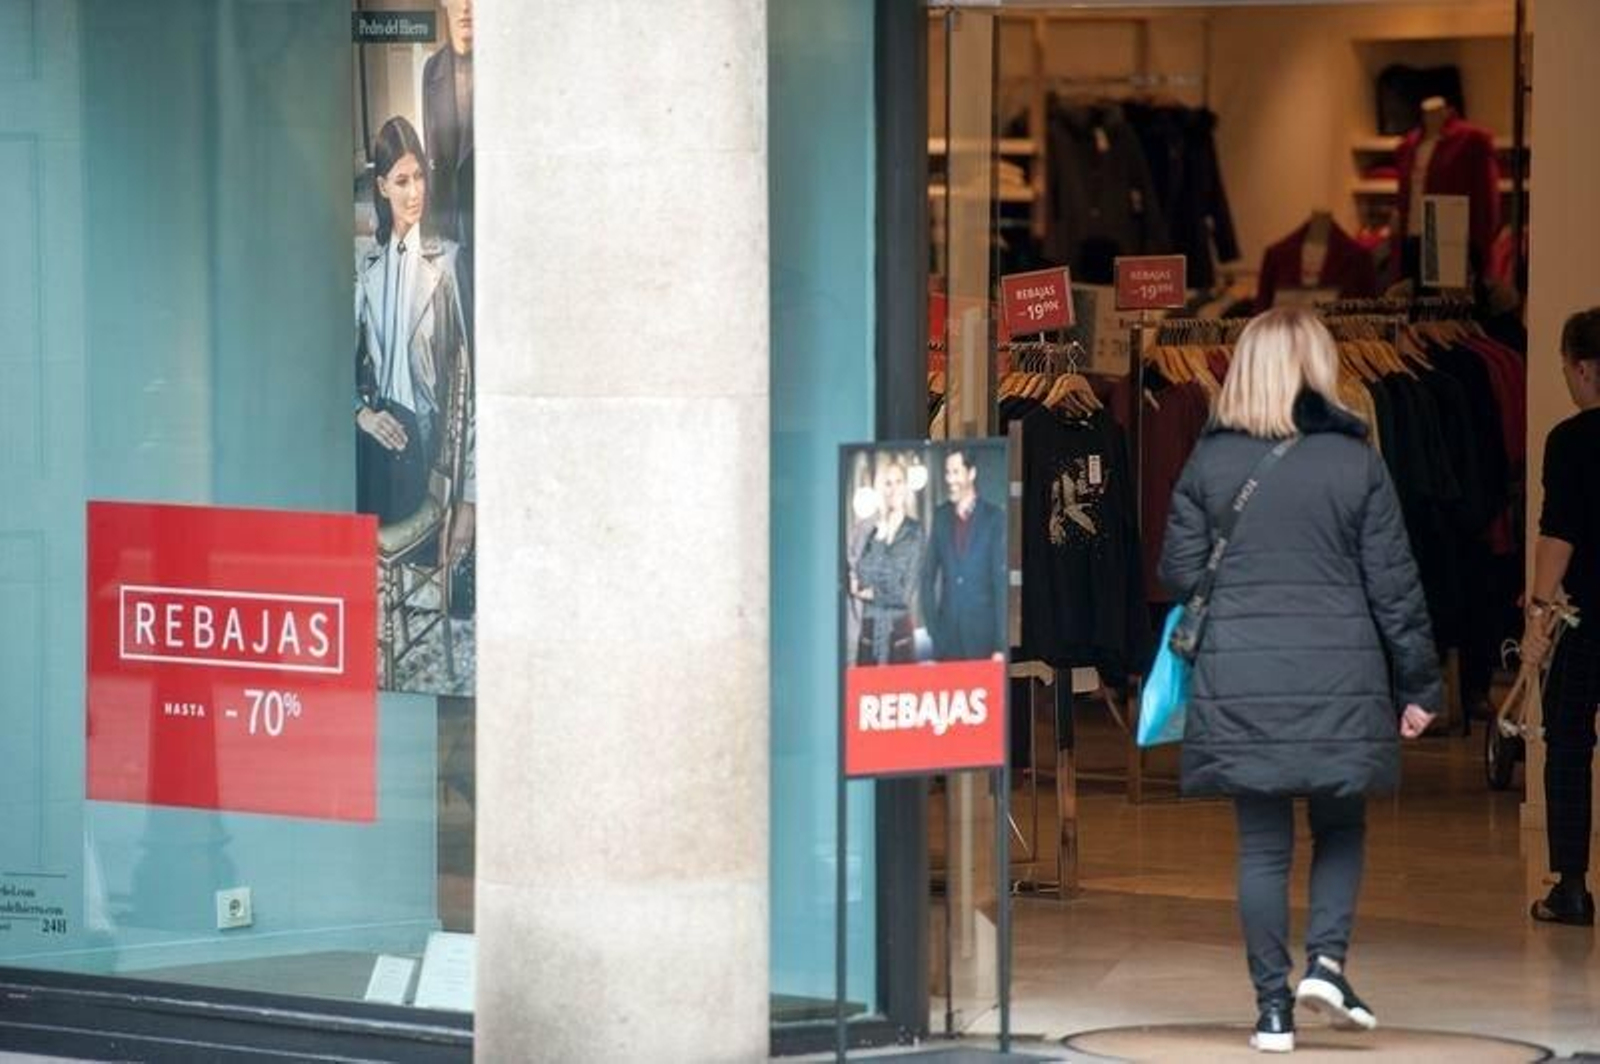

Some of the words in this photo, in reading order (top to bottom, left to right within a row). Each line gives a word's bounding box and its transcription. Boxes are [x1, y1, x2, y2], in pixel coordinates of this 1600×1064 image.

[1129, 269, 1172, 282] REBAJAS
[1015, 285, 1056, 301] REBAJAS
[135, 601, 330, 657] REBAJAS
[164, 702, 205, 717] HASTA
[859, 687, 988, 736] REBAJAS
[42, 918, 67, 934] 24H
